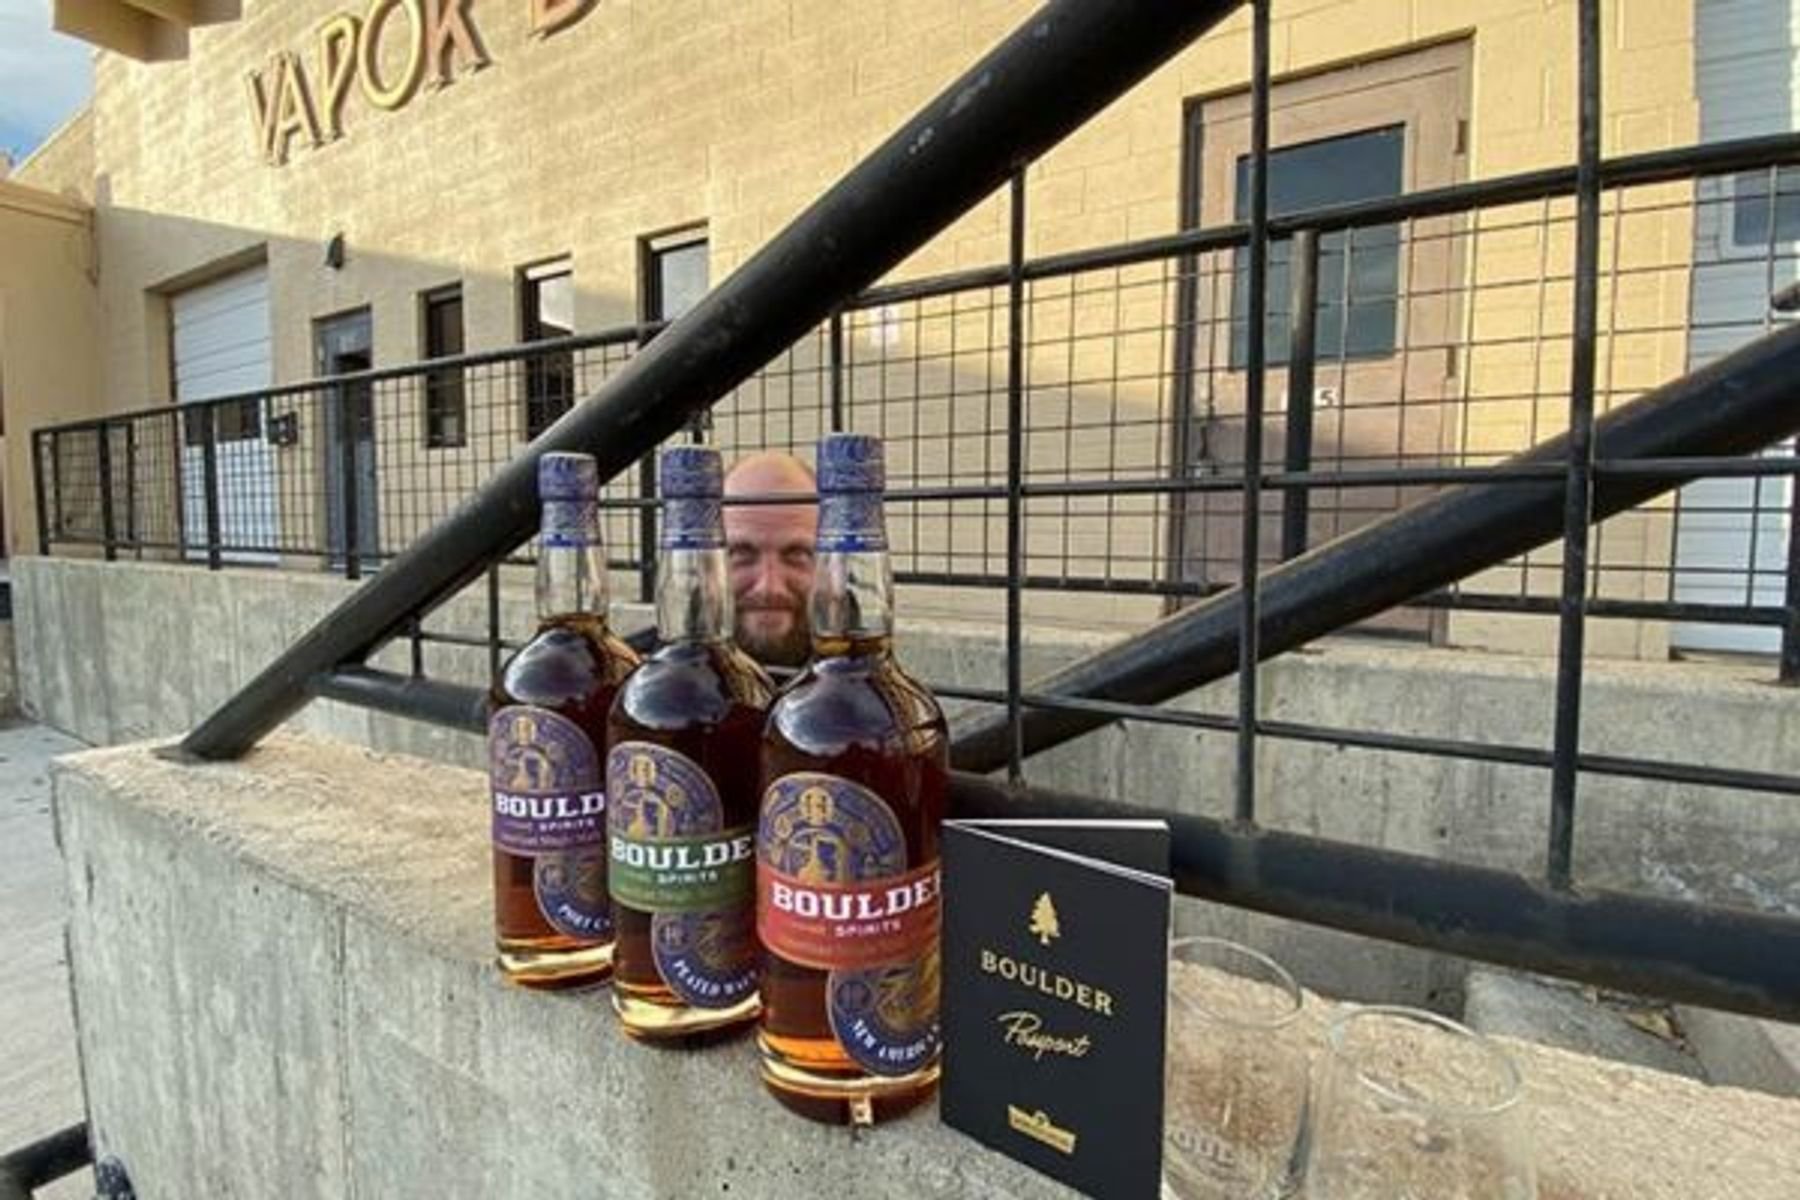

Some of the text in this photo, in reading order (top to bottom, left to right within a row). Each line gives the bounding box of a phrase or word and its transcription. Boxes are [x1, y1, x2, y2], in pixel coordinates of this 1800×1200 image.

[657, 869, 719, 884] SPIRITS
[834, 918, 901, 938] SPIRITS
[980, 949, 1113, 1016] BOULDER
